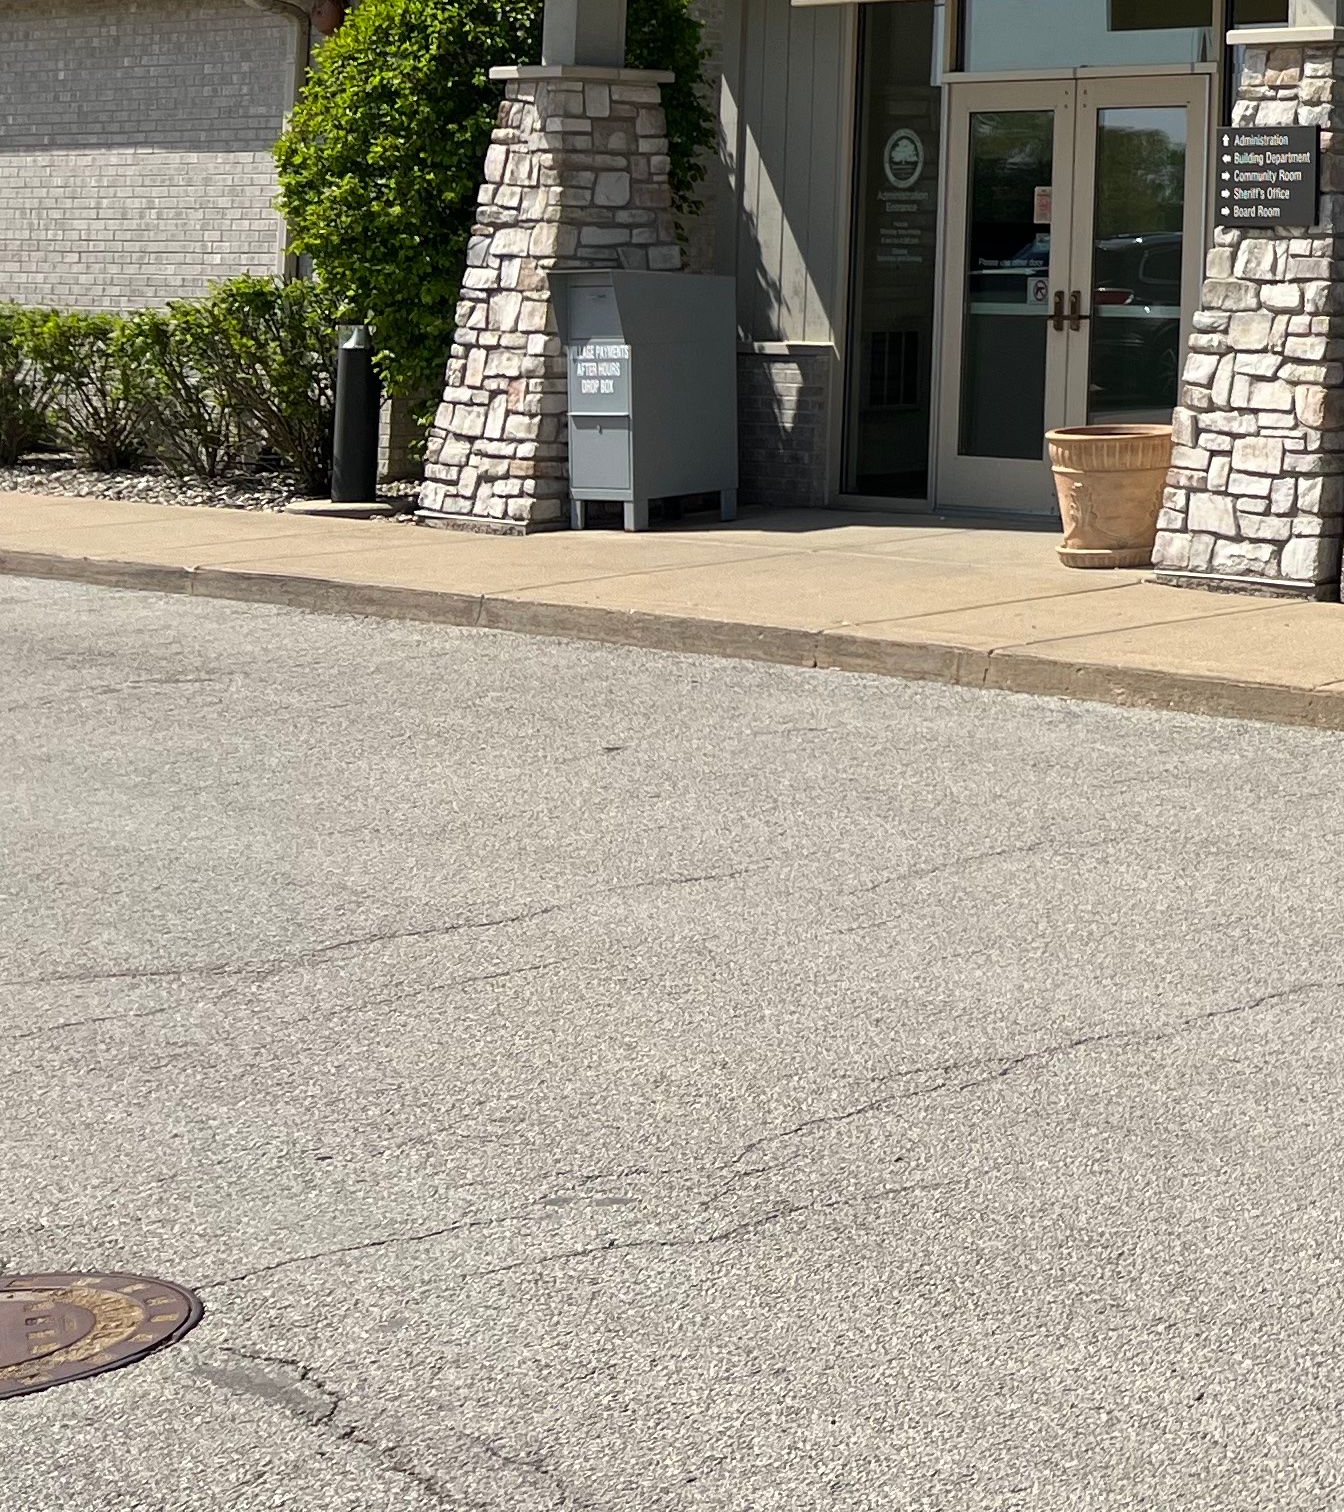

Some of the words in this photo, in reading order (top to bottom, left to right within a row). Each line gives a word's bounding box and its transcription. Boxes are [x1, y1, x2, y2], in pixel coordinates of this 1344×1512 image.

[1233, 134, 1289, 146] Administration
[1233, 152, 1264, 166] Building
[1265, 151, 1311, 166] Department
[1233, 170, 1277, 183] Community
[1279, 169, 1302, 181] Room
[1233, 187, 1265, 200] Sheriff's
[1267, 187, 1290, 199] Office
[1233, 205, 1256, 217] Board
[1257, 205, 1281, 217] Room
[595, 344, 629, 359] PAYMENTS
[576, 362, 597, 377] AFTER
[598, 361, 621, 377] HOURS
[581, 379, 599, 394] DROP
[600, 379, 614, 394] BOX
